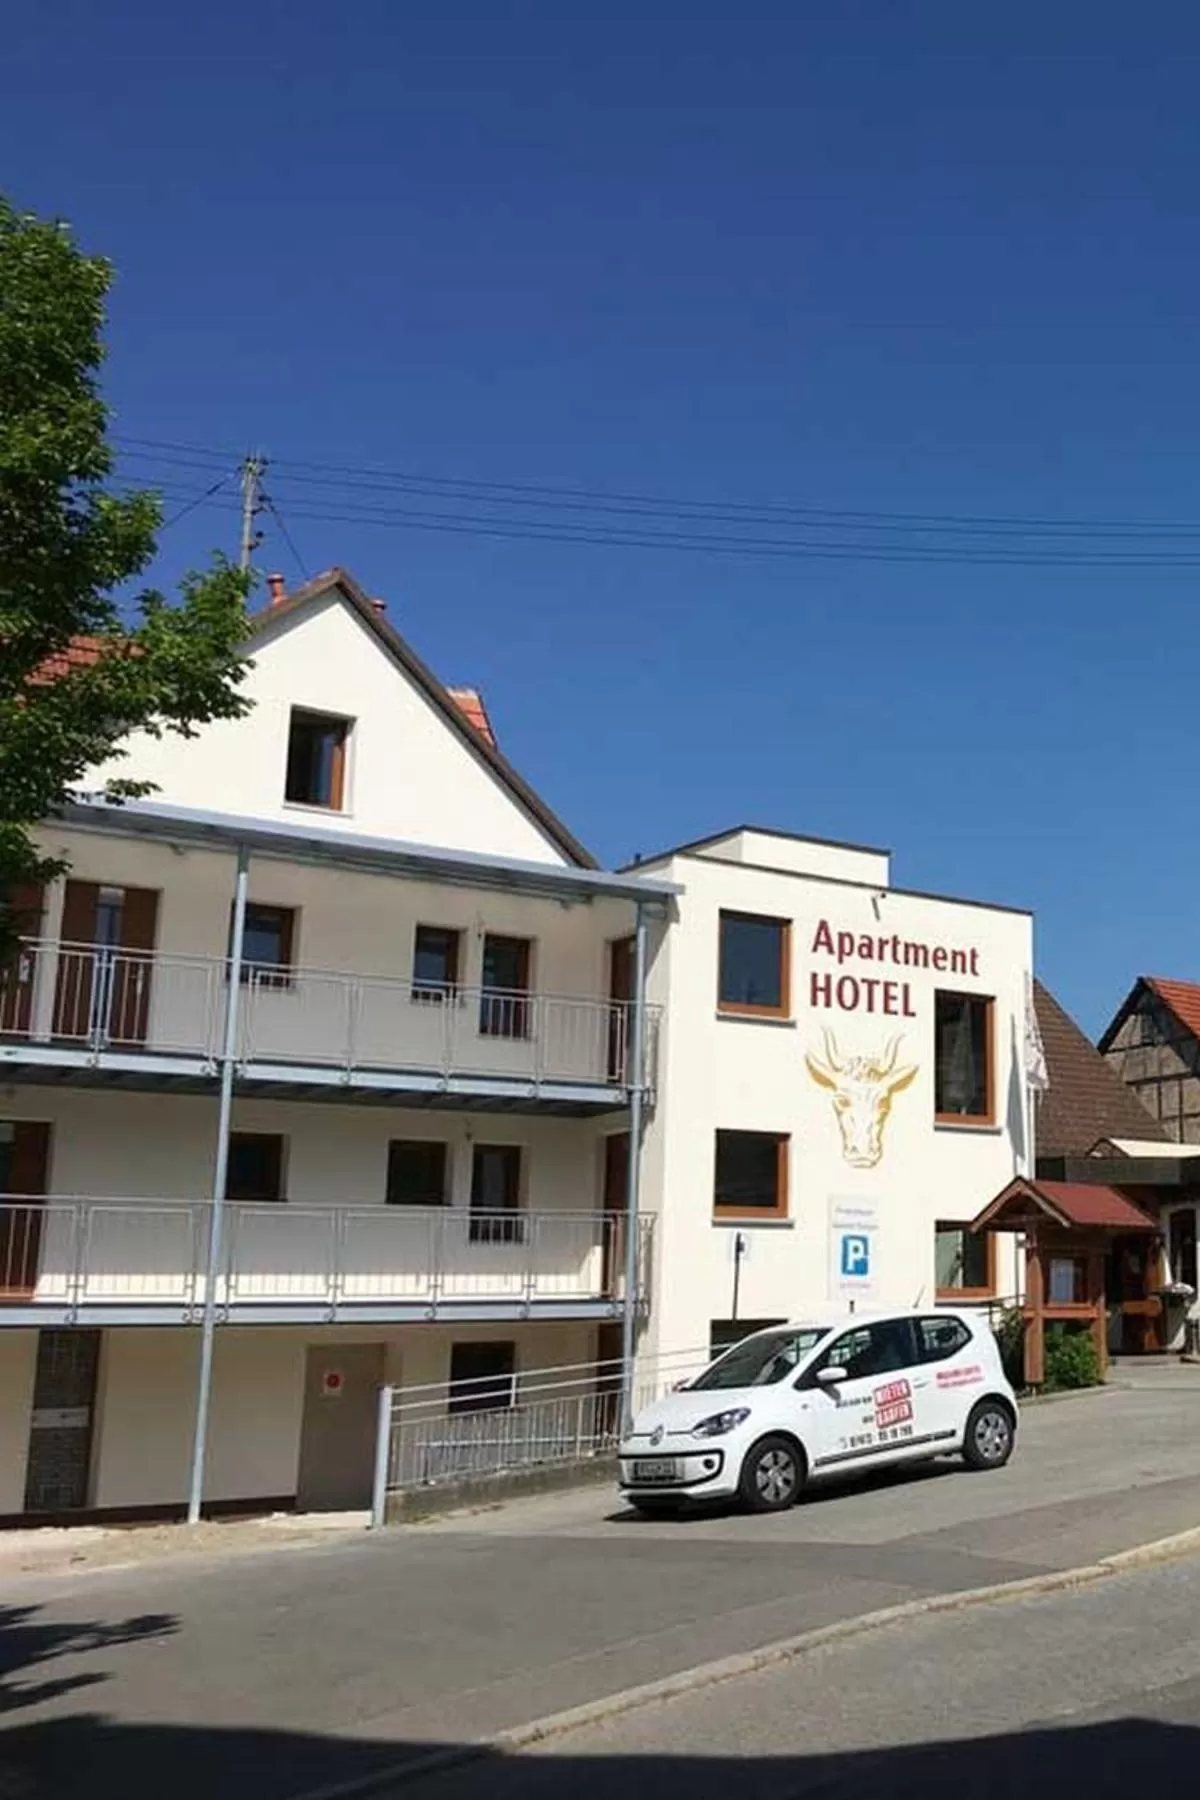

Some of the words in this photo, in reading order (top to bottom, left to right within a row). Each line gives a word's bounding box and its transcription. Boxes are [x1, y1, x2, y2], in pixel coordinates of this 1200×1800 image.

[812, 919, 980, 976] Apartment
[810, 972, 916, 1017] HOTEL
[847, 1239, 865, 1270] P
